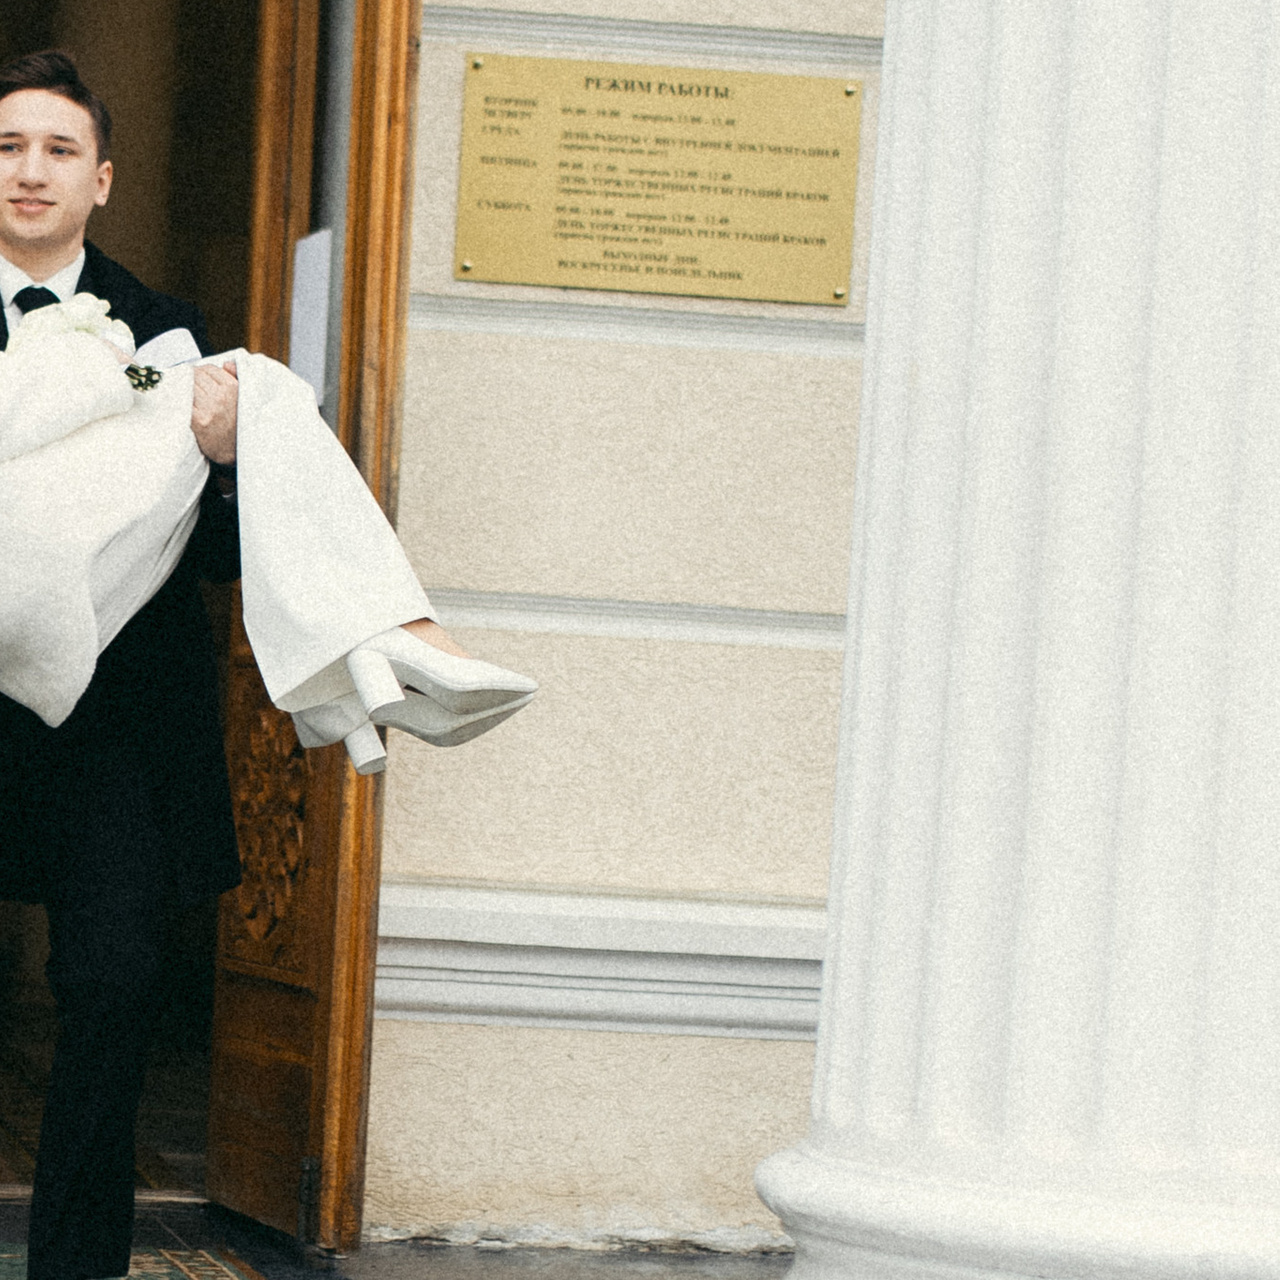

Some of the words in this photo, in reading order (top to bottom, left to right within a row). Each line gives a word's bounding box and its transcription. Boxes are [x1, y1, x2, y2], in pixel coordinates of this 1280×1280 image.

[584, 76, 650, 93] РЕЖИМ
[594, 132, 639, 143] РАБОТЫ
[786, 191, 828, 202] БРАКОВ
[783, 235, 826, 246] БРАКОВ
